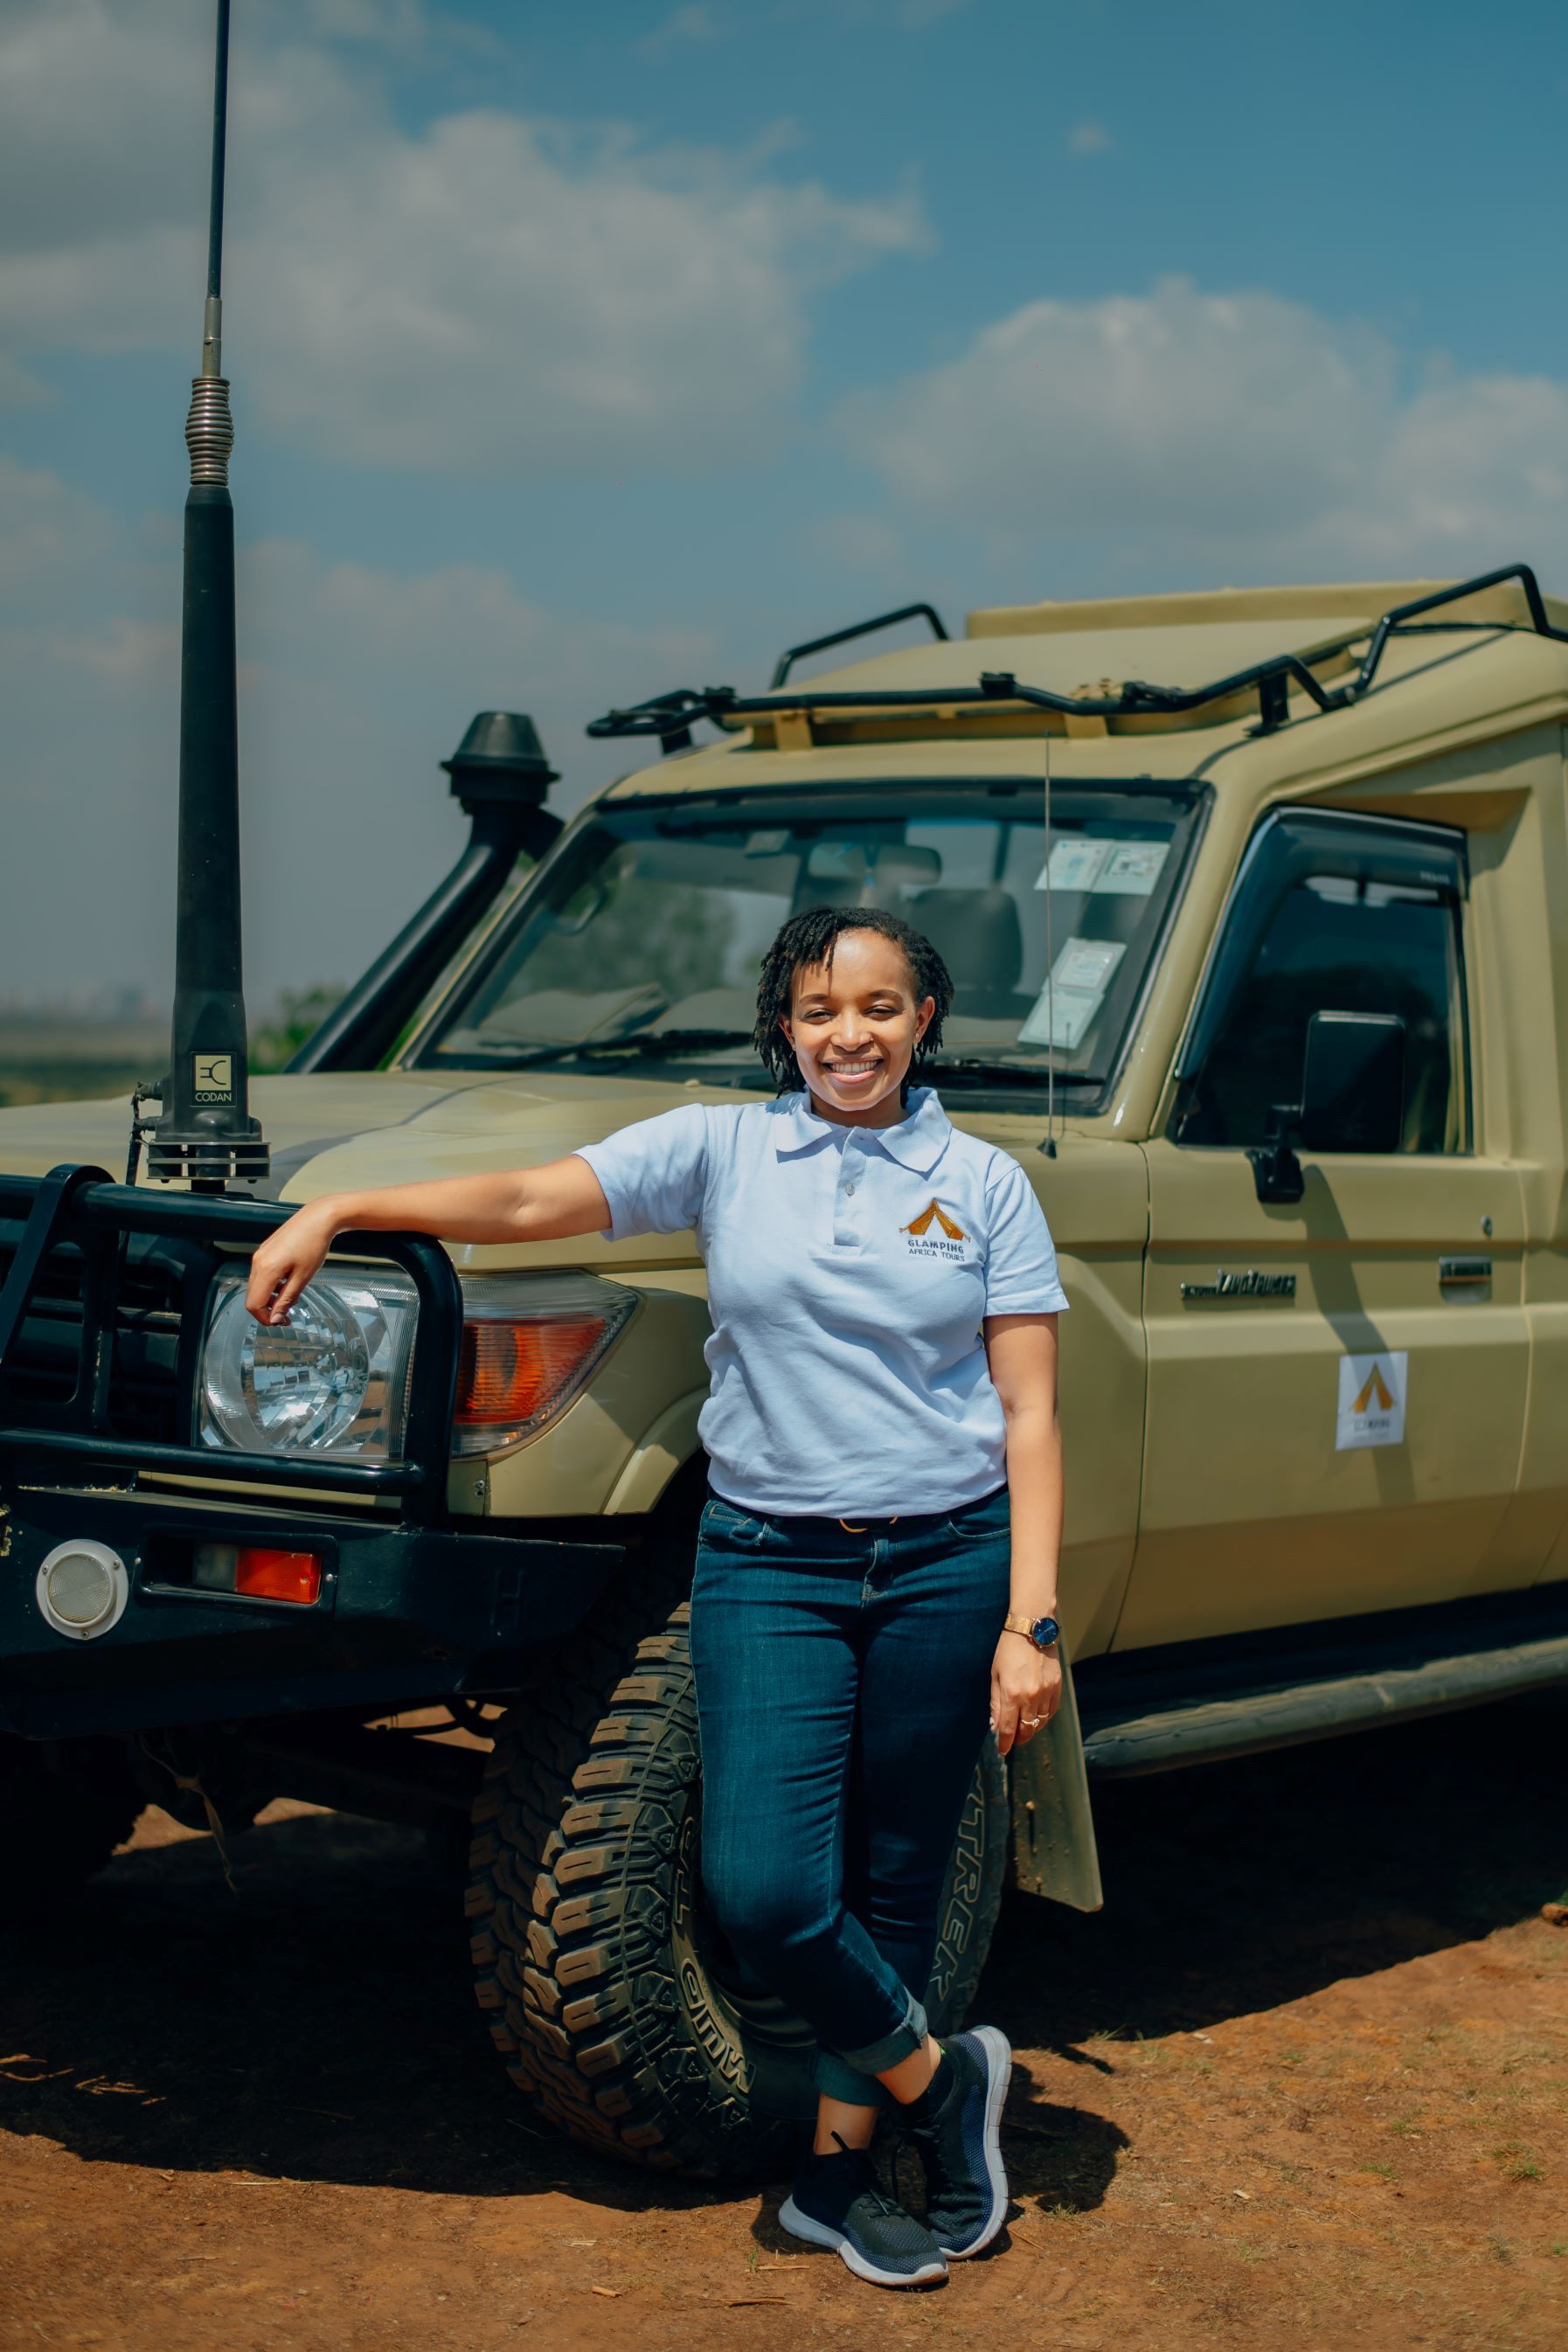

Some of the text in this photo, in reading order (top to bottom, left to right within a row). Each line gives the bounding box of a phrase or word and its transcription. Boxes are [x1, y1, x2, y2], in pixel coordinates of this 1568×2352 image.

[195, 1092, 232, 1102] CODAN
[908, 1239, 964, 1254] GLAMPING
[909, 1248, 965, 1261] AFRICA TOURS
